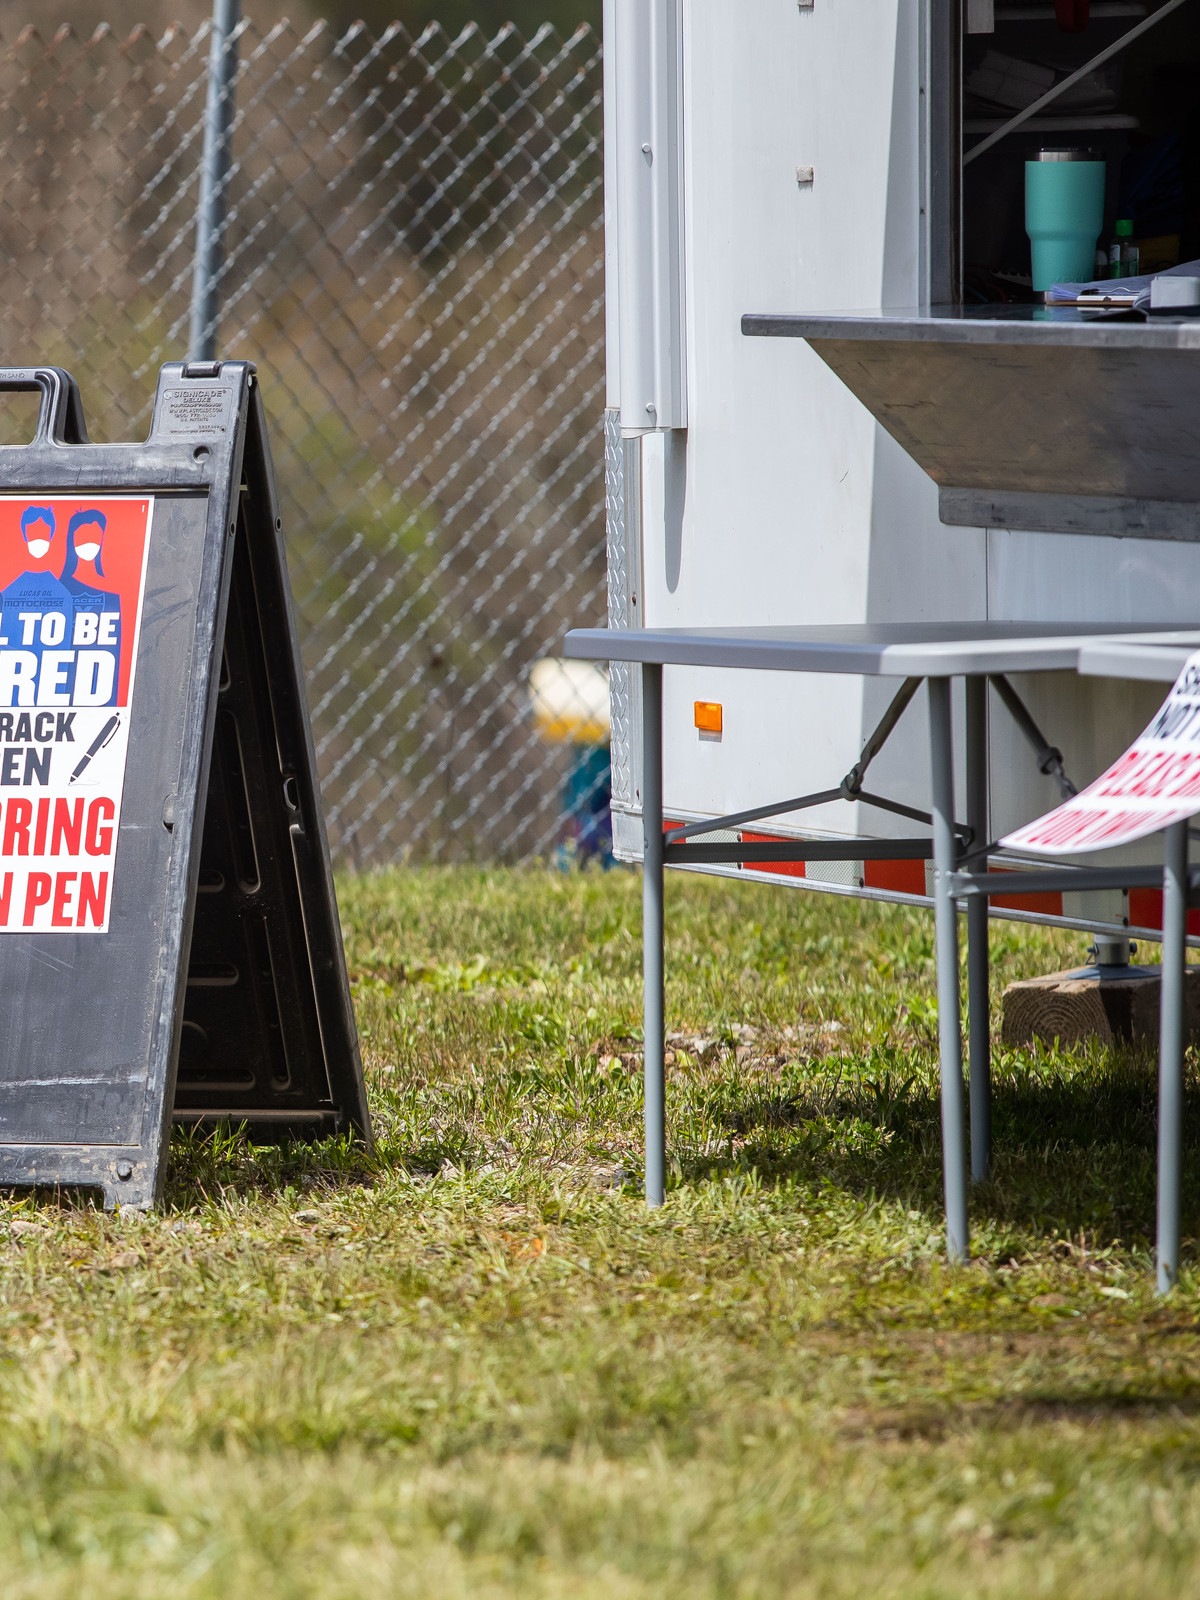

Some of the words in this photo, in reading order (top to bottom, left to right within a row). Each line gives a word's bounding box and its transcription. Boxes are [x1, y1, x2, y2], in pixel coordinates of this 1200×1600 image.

[18, 612, 67, 646] TO
[73, 612, 121, 646] BE
[22, 871, 109, 927] PEN
